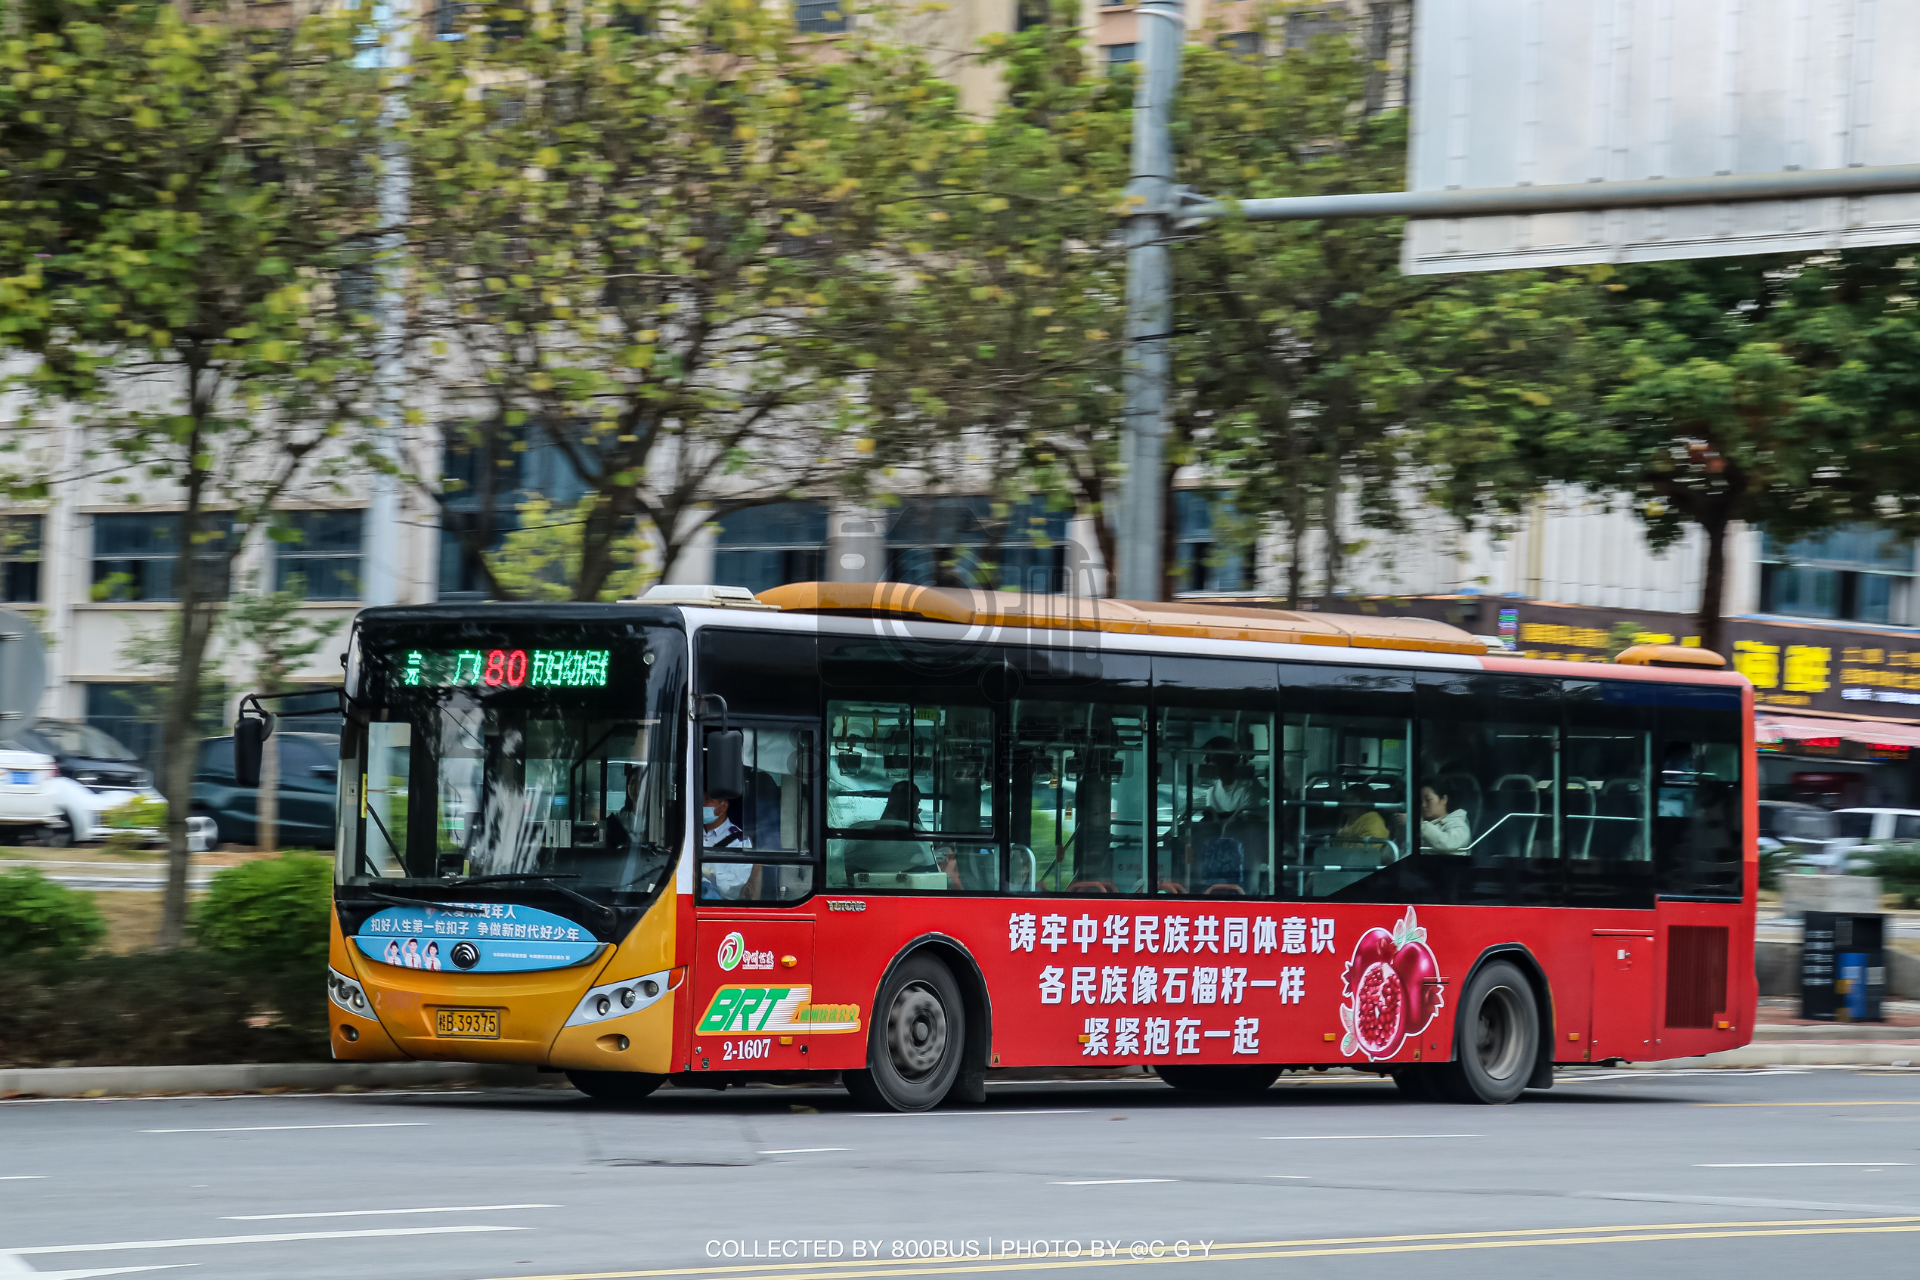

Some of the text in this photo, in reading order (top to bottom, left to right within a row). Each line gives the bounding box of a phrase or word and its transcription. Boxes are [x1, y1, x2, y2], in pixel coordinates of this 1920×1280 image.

[485, 650, 527, 686] 80
[371, 918, 579, 941] 扣好人生第一粒扣子 争做新时代好少年
[1009, 913, 1335, 954] 铸牢中华民族共同体意识
[1039, 966, 1306, 1006] 各民族像石榴籽一样
[699, 988, 790, 1031] BRT
[723, 1039, 771, 1060] 2-1607
[1083, 1017, 1259, 1055] 紧紧抱在一起
